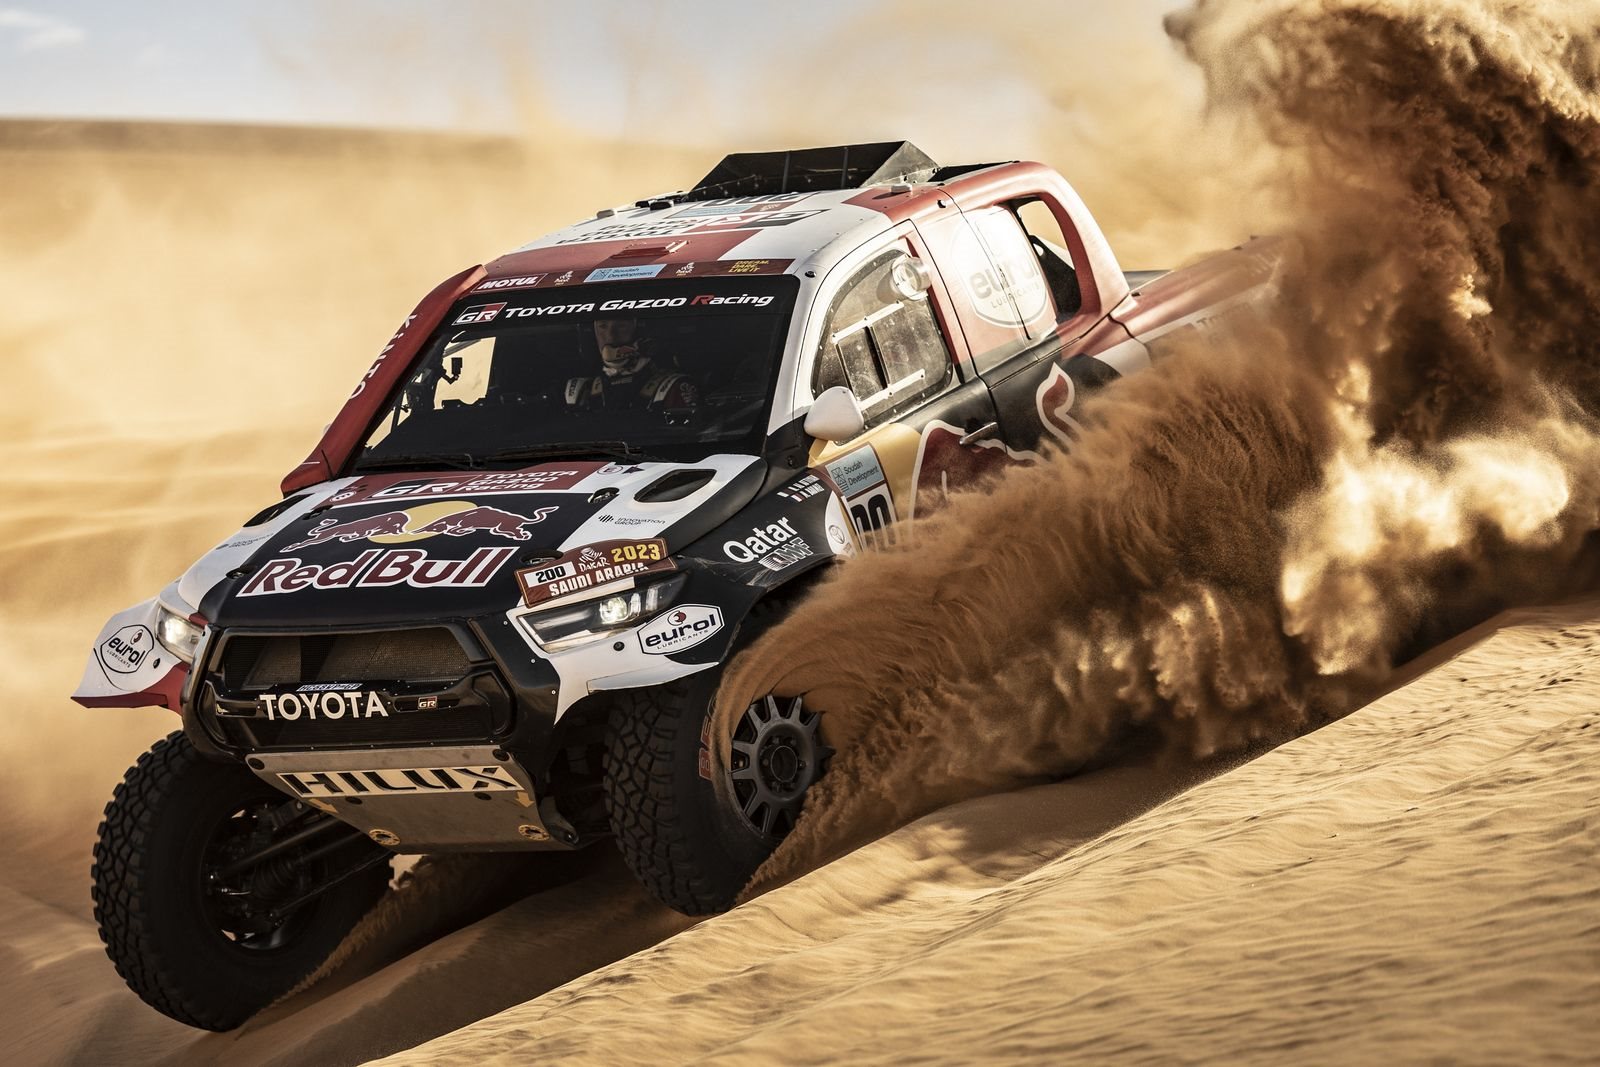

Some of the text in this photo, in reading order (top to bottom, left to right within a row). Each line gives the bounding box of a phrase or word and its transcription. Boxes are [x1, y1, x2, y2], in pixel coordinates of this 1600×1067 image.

[477, 276, 539, 290] MOTUL
[456, 293, 775, 323] GR TOYOTA GAZOO Racing
[484, 471, 580, 480] TOYOTA
[843, 460, 863, 475] Soudah
[847, 465, 880, 486] Development
[371, 482, 460, 498] GR
[454, 483, 545, 492] Racing
[468, 477, 559, 486] GAZOO
[722, 516, 798, 563] Qatar
[577, 543, 661, 573] DAKAR 2023
[535, 565, 567, 584] 200
[548, 573, 592, 597] SAUDI
[645, 614, 717, 648] eurol
[656, 629, 709, 650] LUBRICANTS
[108, 637, 146, 666] eurol
[259, 690, 389, 721] TOYOTA
[418, 701, 437, 709] GR
[279, 766, 517, 795] HILUX
